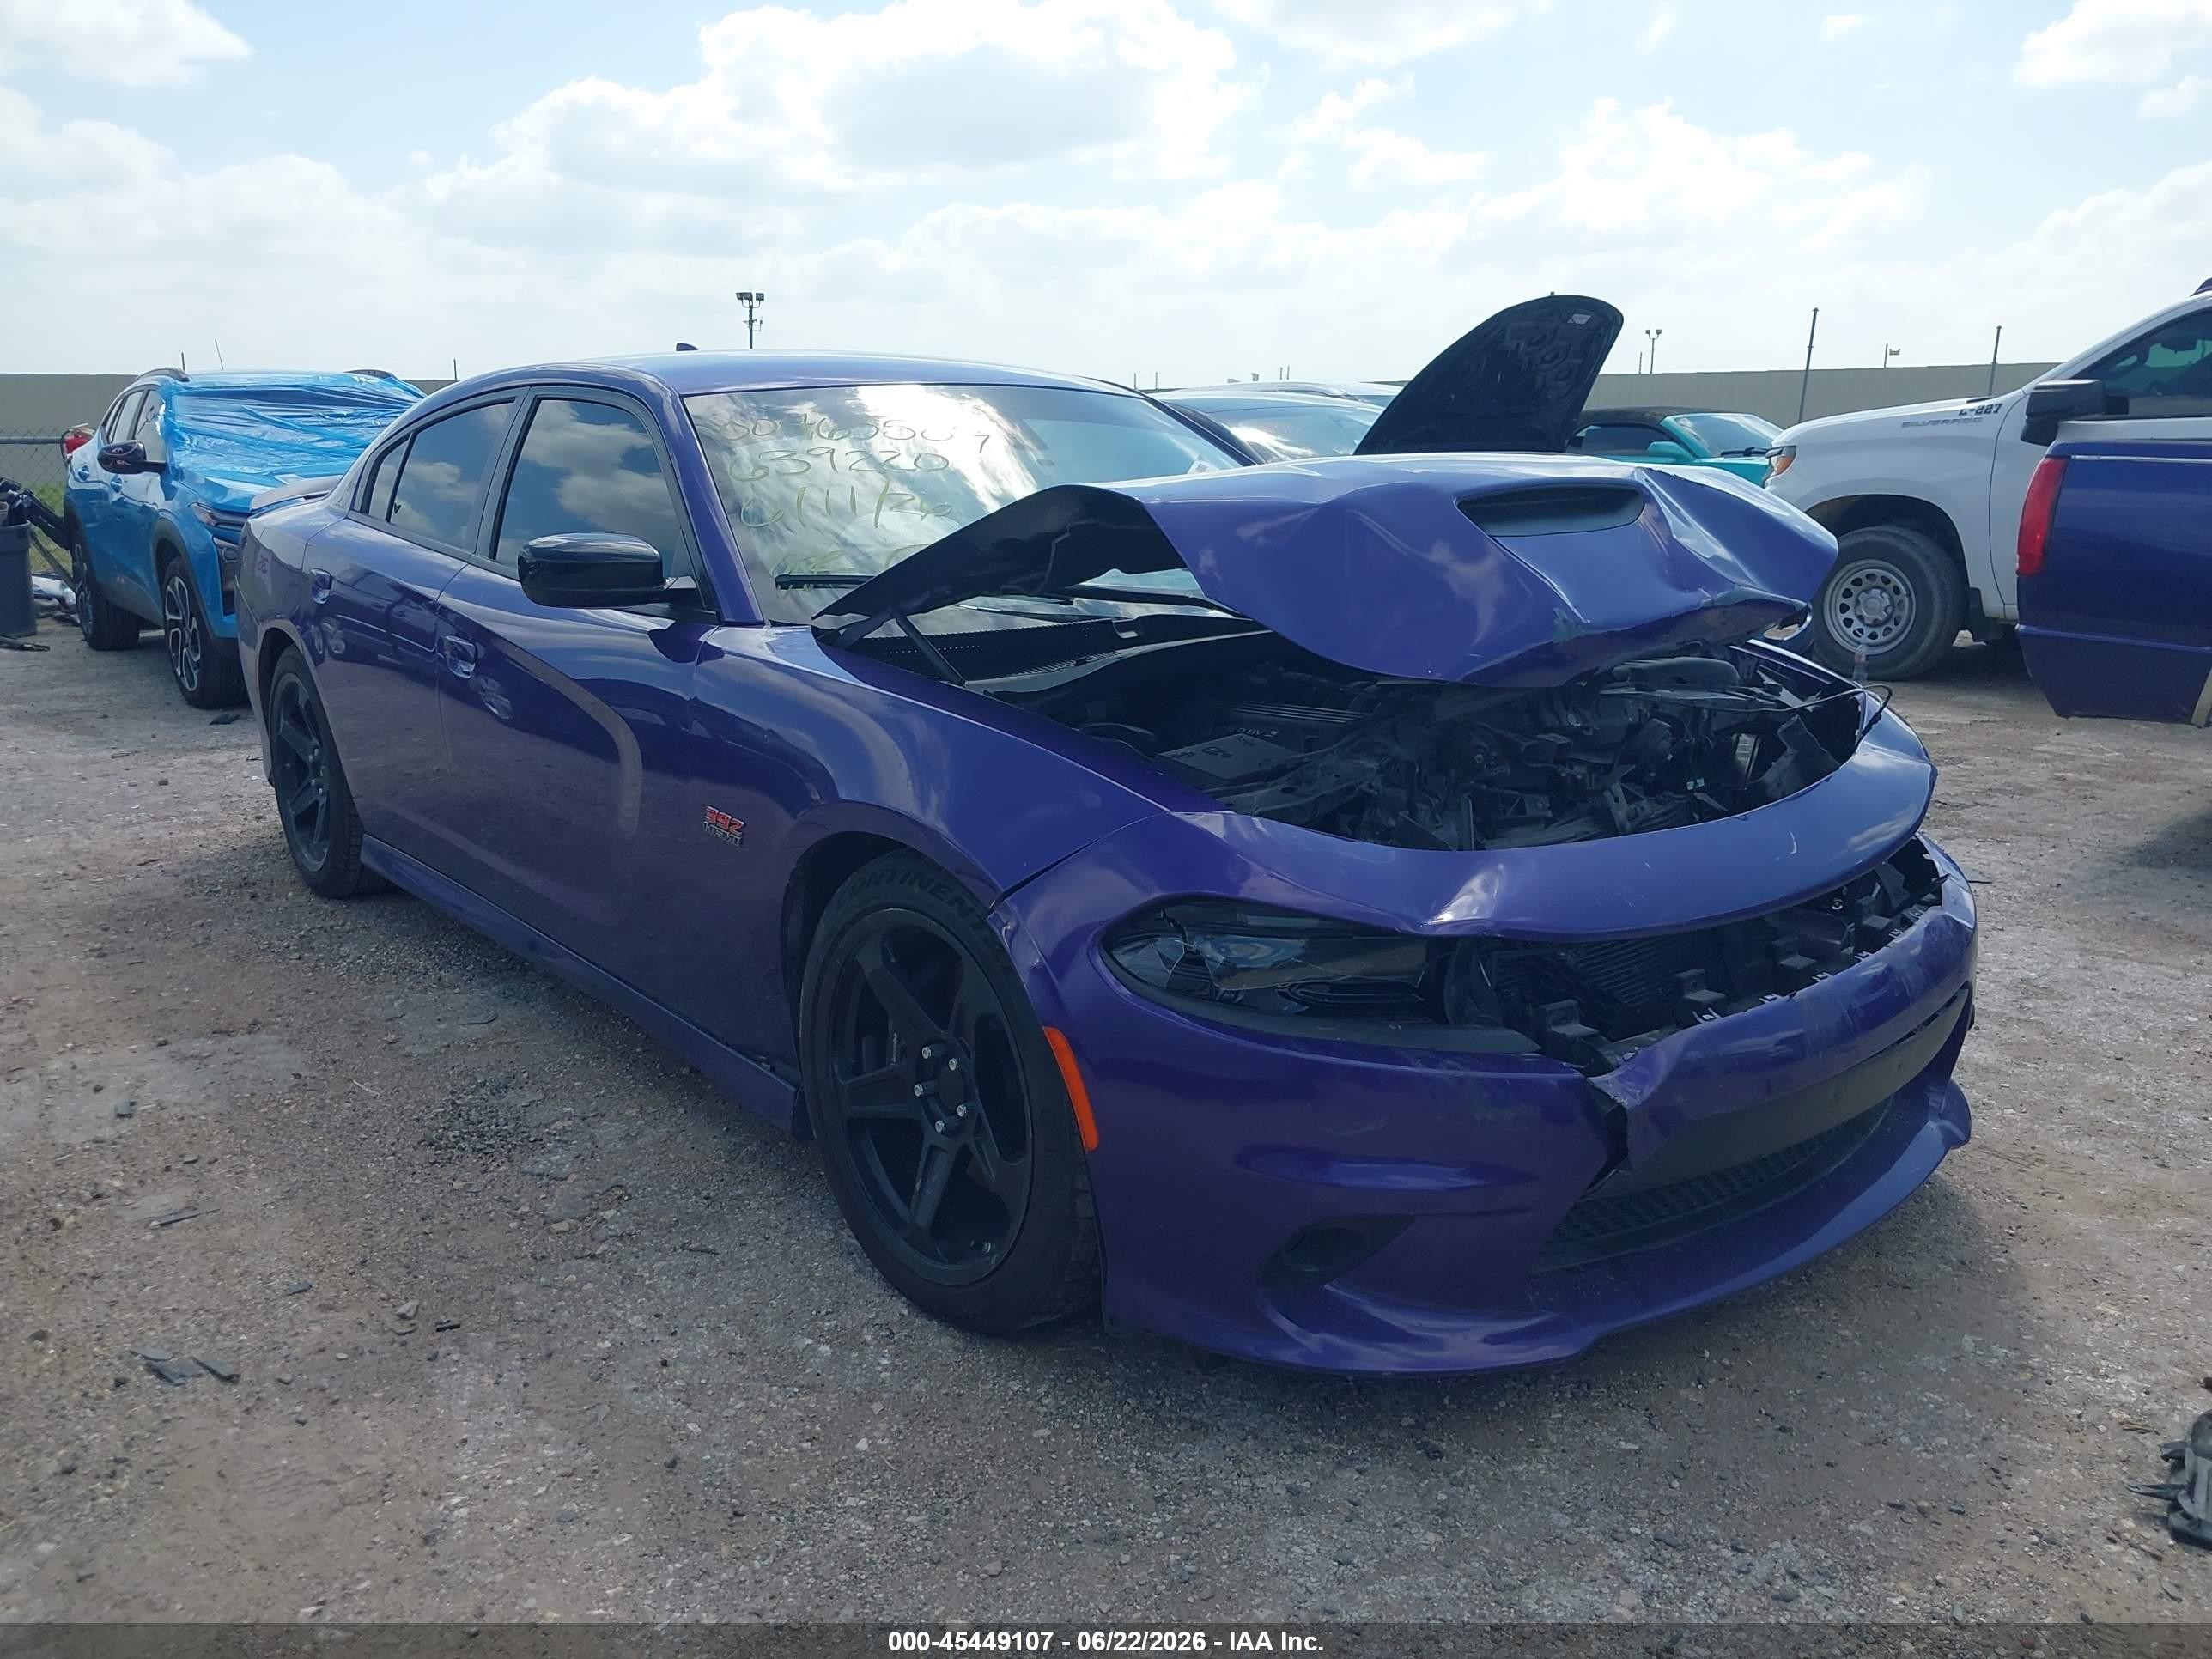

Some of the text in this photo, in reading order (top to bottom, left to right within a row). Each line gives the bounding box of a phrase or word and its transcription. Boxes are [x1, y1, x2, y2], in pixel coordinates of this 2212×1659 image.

[1900, 417, 1983, 428] SILVERADO
[729, 447, 950, 482] 639220
[740, 481, 954, 528] 6/11/26
[704, 805, 745, 836] 392
